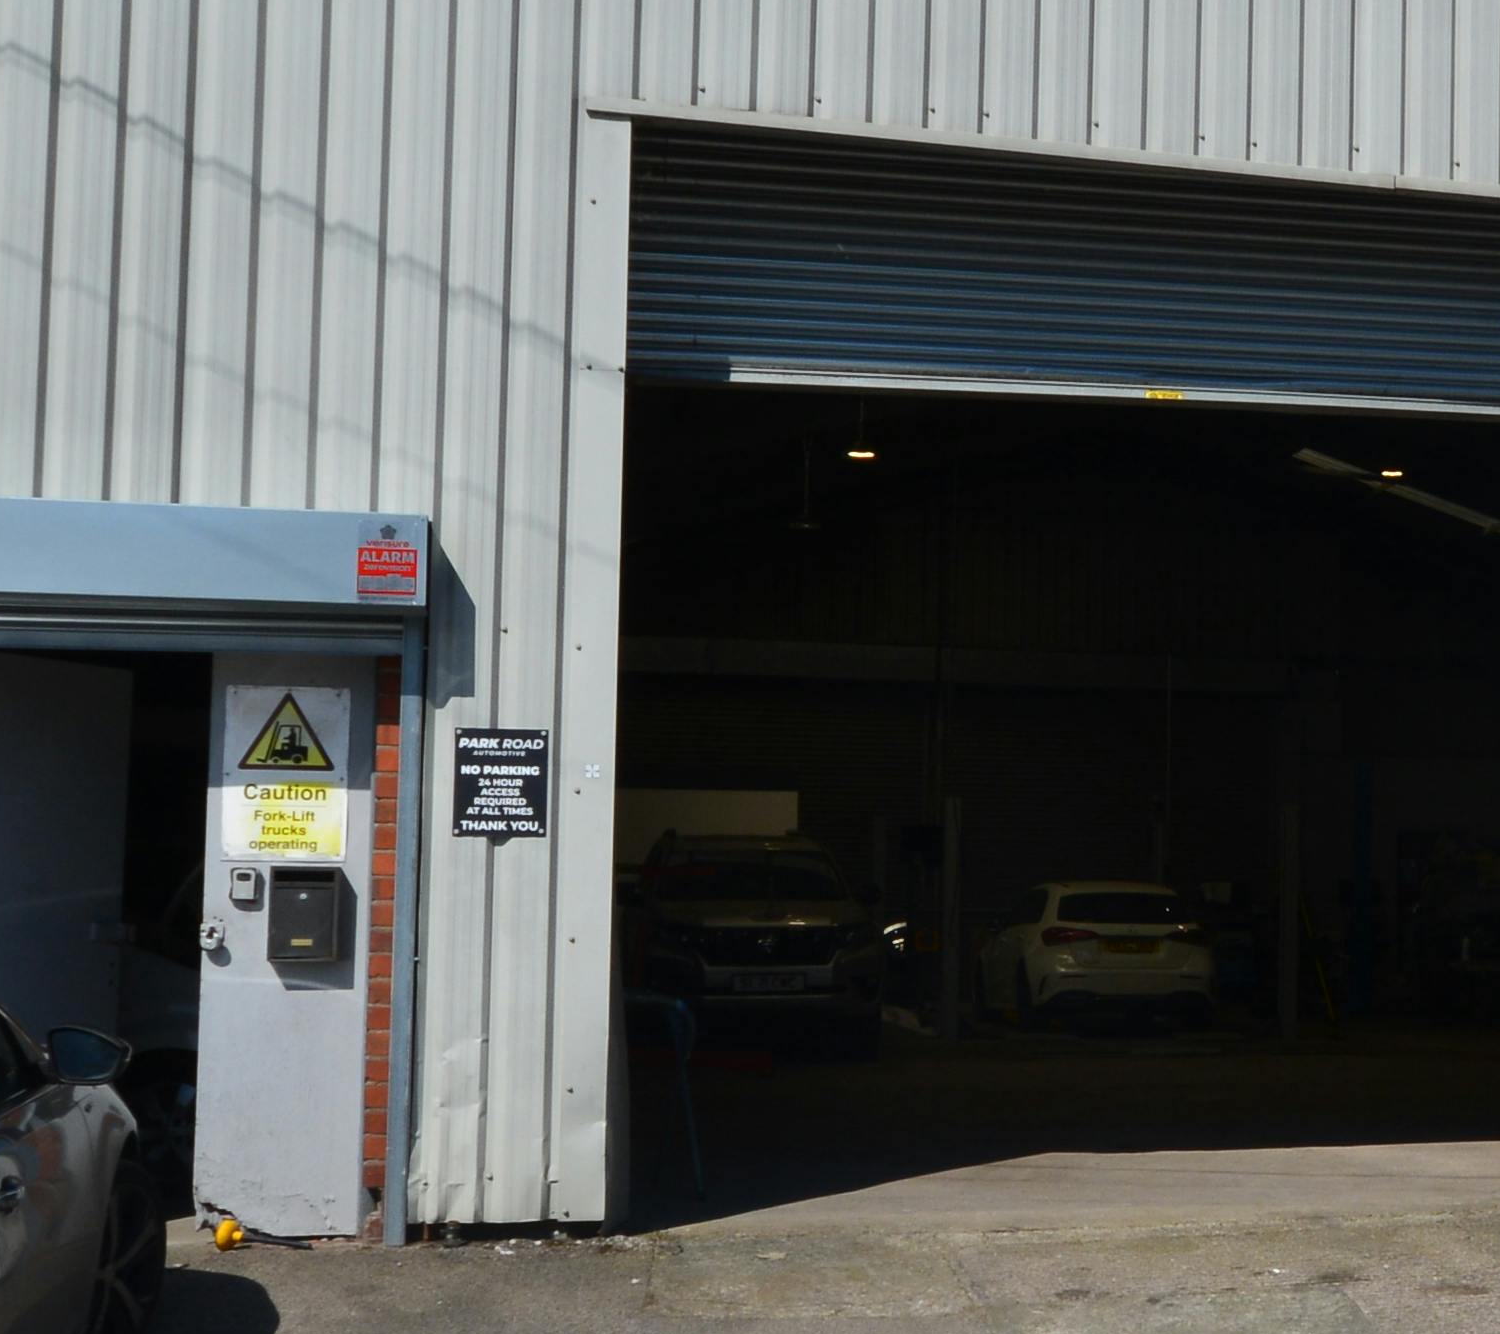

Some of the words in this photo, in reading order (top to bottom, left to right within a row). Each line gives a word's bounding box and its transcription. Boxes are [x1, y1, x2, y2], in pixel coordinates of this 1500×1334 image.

[360, 550, 415, 564] ALARM
[458, 737, 500, 748] PARK
[502, 738, 544, 750] ROAD
[460, 765, 481, 775] NO
[483, 765, 540, 776] PARKING
[477, 778, 491, 787] 24
[492, 778, 524, 787] HOUR
[243, 783, 327, 801] Caution
[480, 787, 521, 796] ACCESS
[473, 797, 527, 807] REQUIRED
[254, 810, 315, 822] Fork-Lift
[466, 806, 480, 815] AT
[481, 806, 501, 816] ALL
[502, 807, 534, 816] TIMES
[261, 825, 307, 836] trucks
[460, 820, 508, 831] THANK
[248, 838, 318, 852] operating
